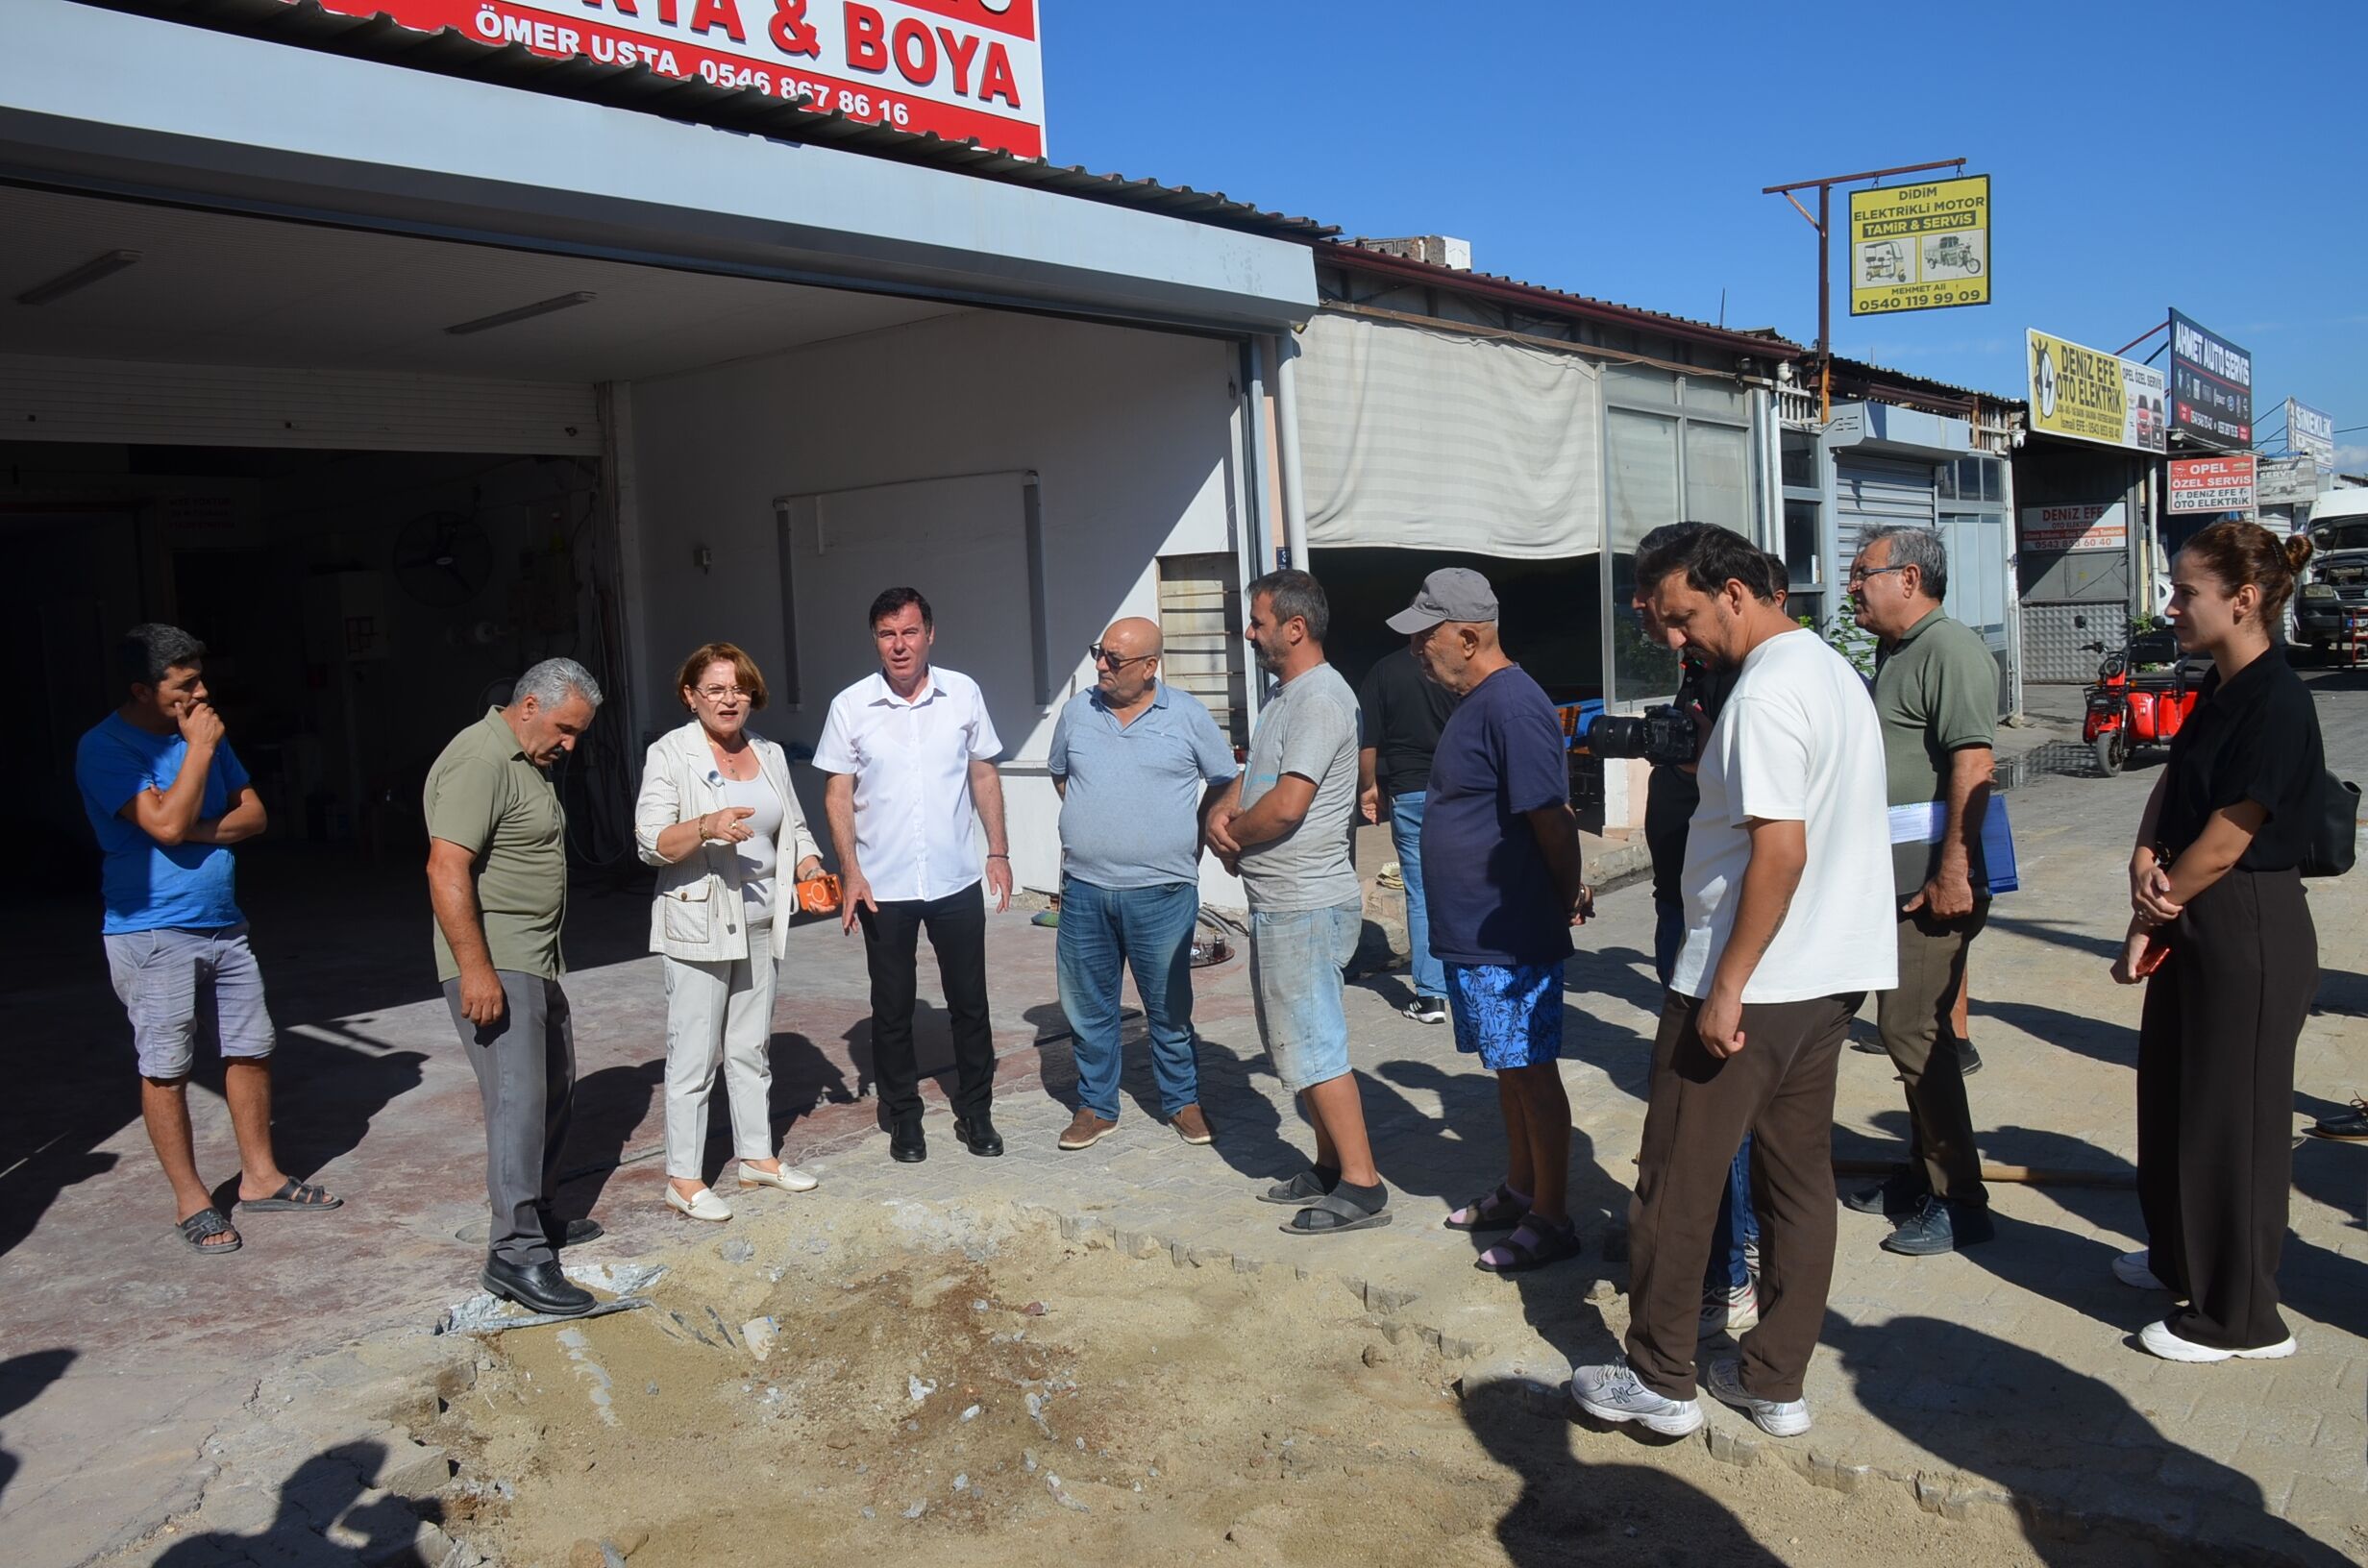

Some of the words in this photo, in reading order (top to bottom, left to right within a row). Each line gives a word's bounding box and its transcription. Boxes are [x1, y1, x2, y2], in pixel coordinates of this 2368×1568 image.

[845, 2, 1021, 109] BOYA
[475, 4, 580, 54] ÖMER
[591, 35, 680, 78] USTA
[700, 59, 772, 96] 0546
[779, 77, 830, 109] 867
[838, 90, 871, 117] 86
[878, 101, 909, 126] 16
[1934, 196, 1985, 212] MOTOR
[1910, 220, 1920, 231] &
[1891, 284, 1931, 295] MEHMET
[1860, 297, 1901, 311] 0540
[1905, 295, 1929, 306] 119
[1934, 293, 1954, 304] 99
[1959, 289, 1981, 302] 09
[2175, 320, 2204, 365] AHMET
[2203, 337, 2225, 376] AUTO
[2096, 356, 2115, 386] EFE
[2056, 372, 2076, 404] OTO
[2189, 462, 2229, 475] OPEL
[2172, 478, 2204, 489] ÖZEL
[2218, 488, 2236, 497] EFE
[2174, 500, 2195, 508] OTO
[2084, 506, 2103, 519] EFE
[2035, 540, 2059, 550] 0543
[2084, 538, 2096, 547] 60
